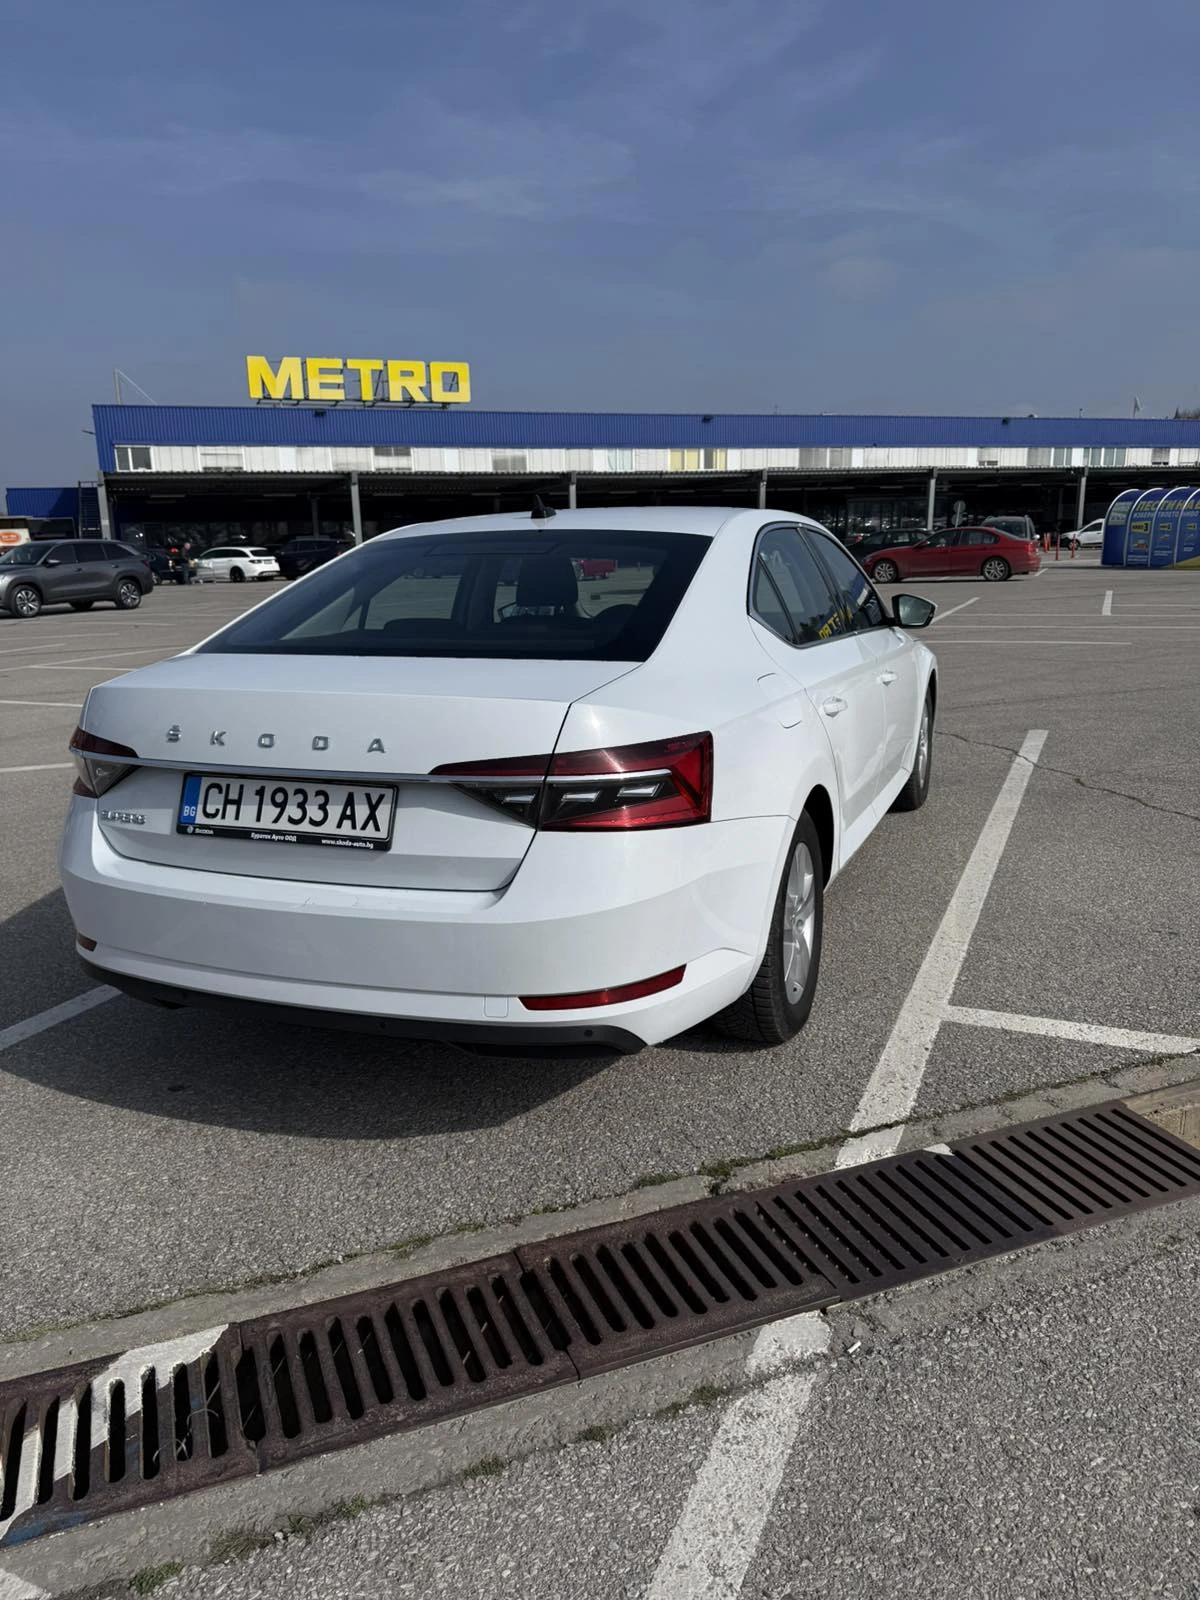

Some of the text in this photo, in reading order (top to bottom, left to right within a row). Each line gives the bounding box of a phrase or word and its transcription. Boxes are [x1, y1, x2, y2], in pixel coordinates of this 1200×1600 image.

[246, 355, 471, 403] METRO
[166, 724, 386, 753] ŠKODA
[101, 809, 146, 825] SUPERB
[183, 805, 196, 817] BG
[202, 783, 386, 832] CH 1933 AX
[321, 838, 374, 850] www.skoda-auto.bg
